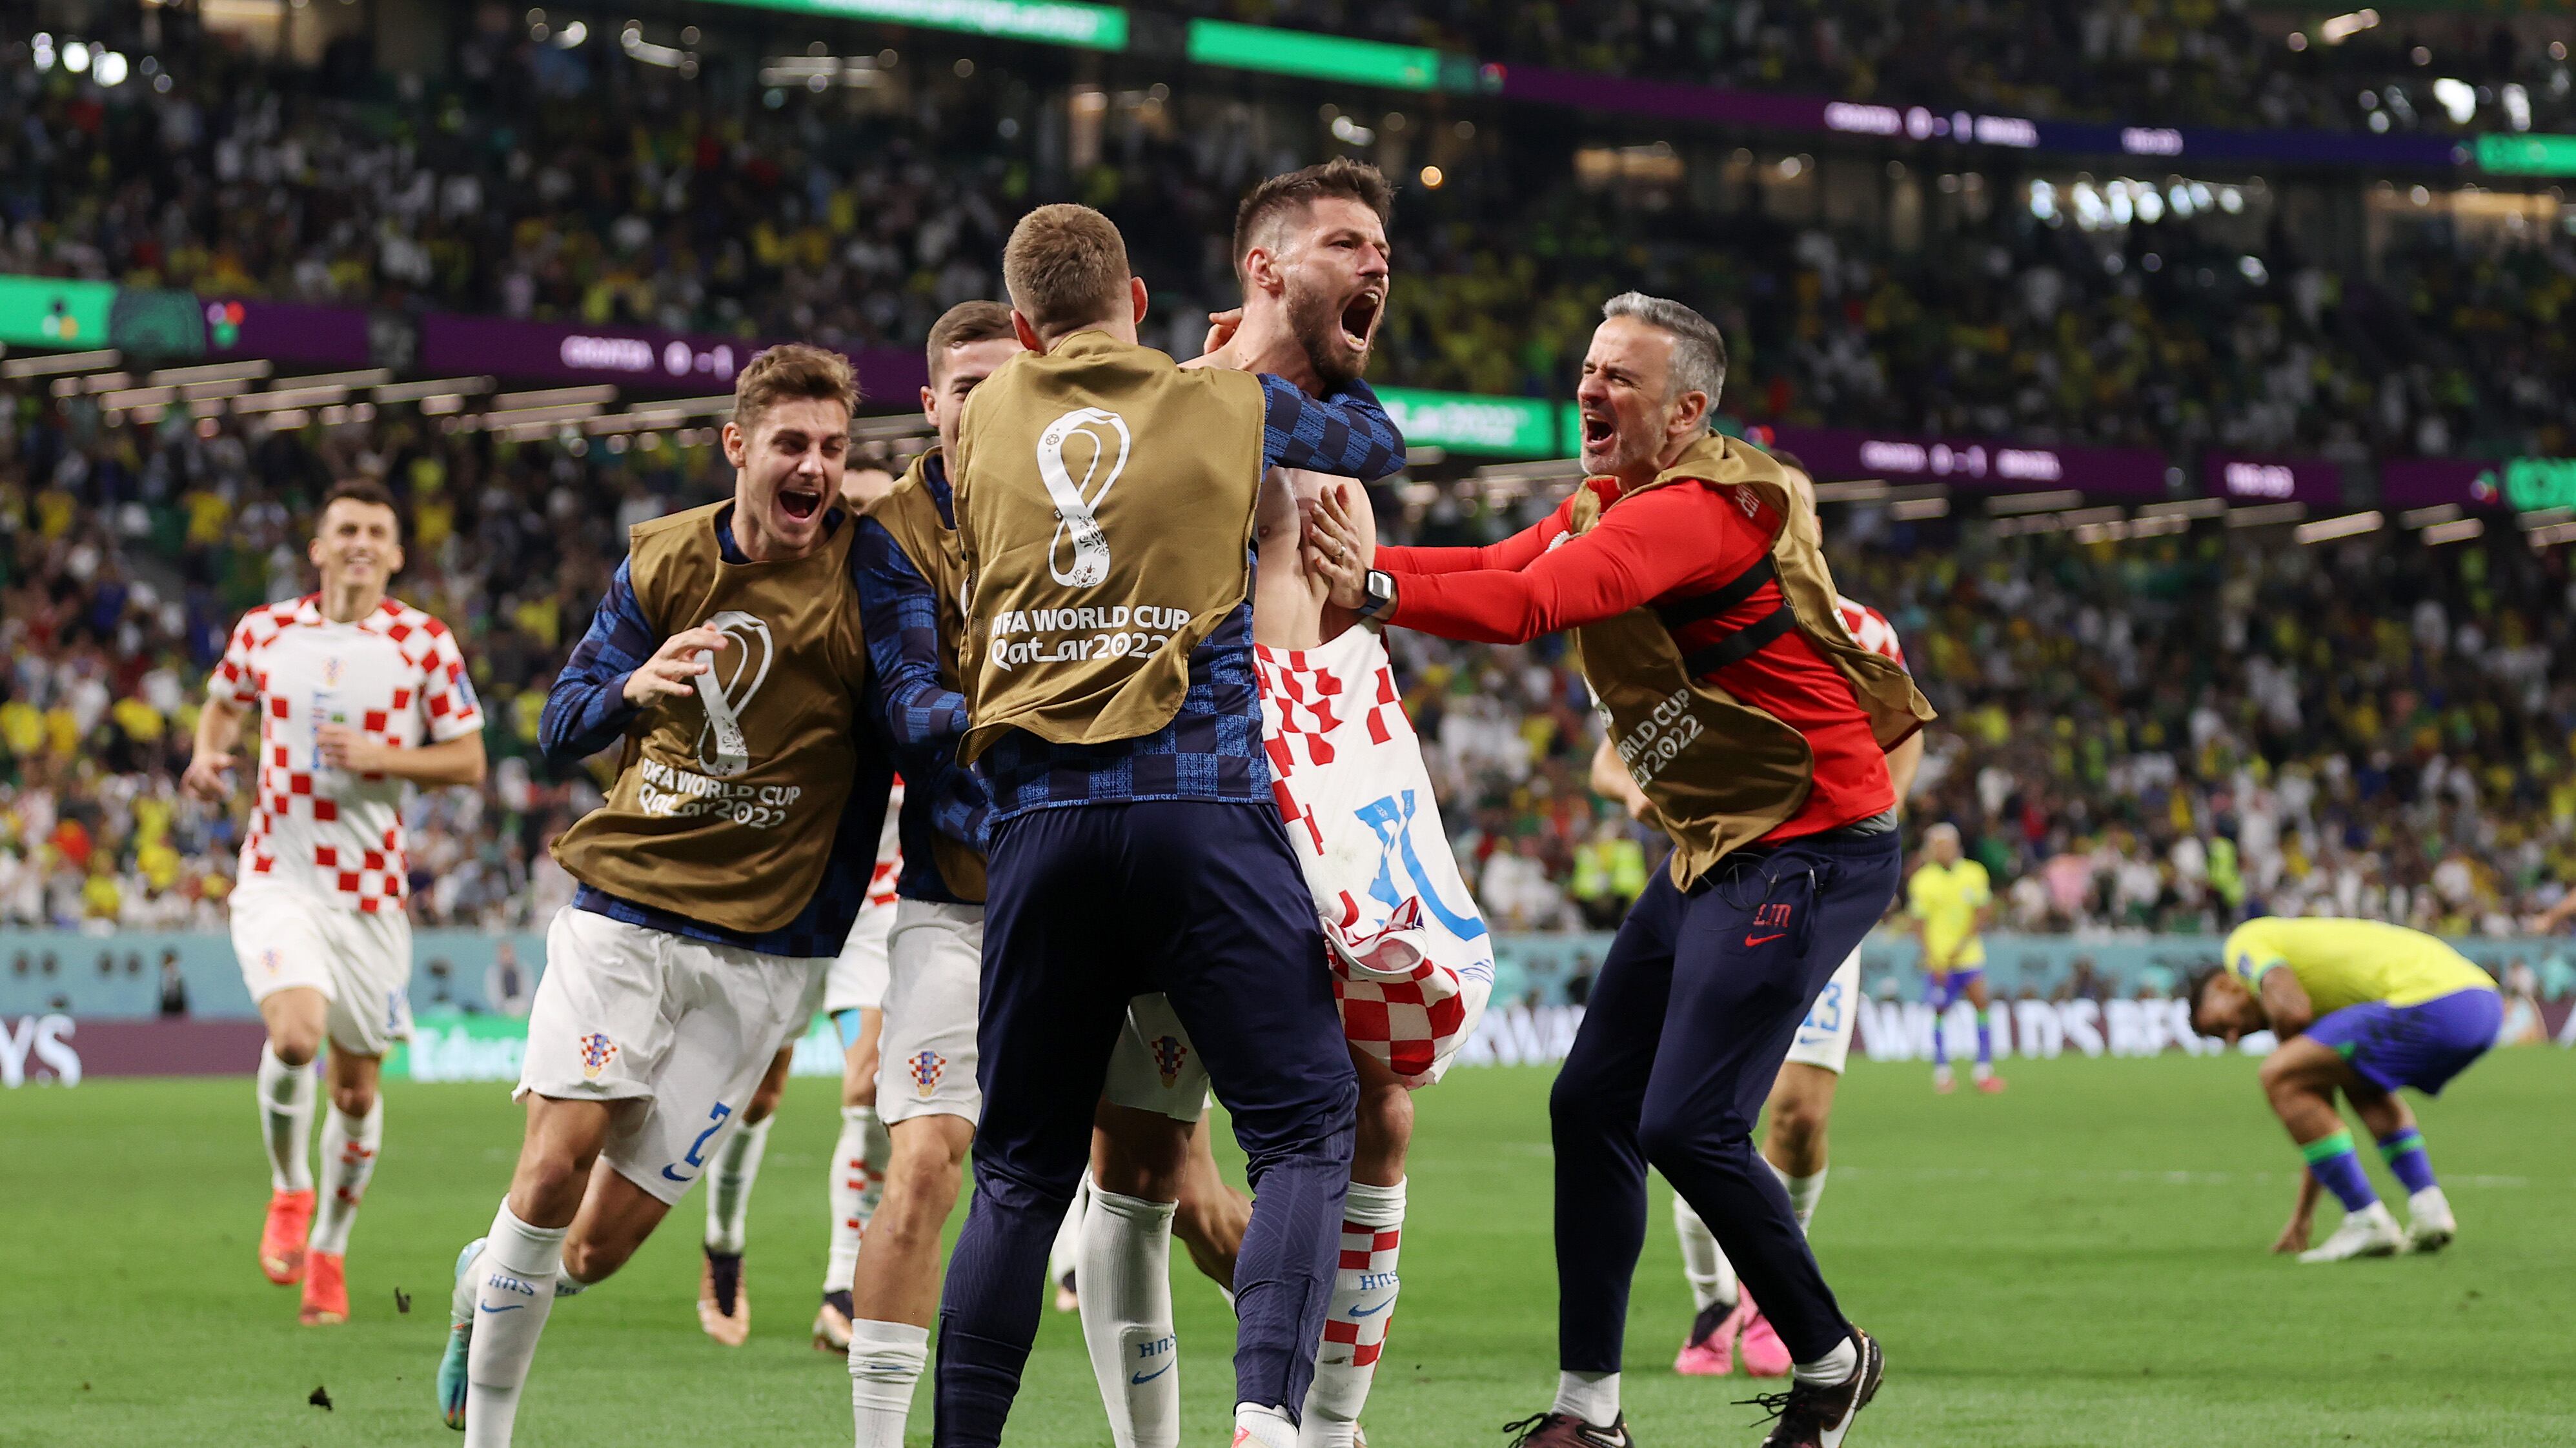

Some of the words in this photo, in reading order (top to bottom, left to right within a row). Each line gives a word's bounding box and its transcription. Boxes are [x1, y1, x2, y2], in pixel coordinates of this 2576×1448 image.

[1031, 605, 1130, 632] WORLD
[1133, 605, 1190, 632] CUP
[1653, 689, 1690, 727] CUP
[1176, 753, 1218, 762] HRVATSKA
[1177, 761, 1218, 770] HRVATSKA
[677, 770, 755, 799] WORLD
[758, 785, 801, 806] CUP
[685, 1101, 731, 1167] 2
